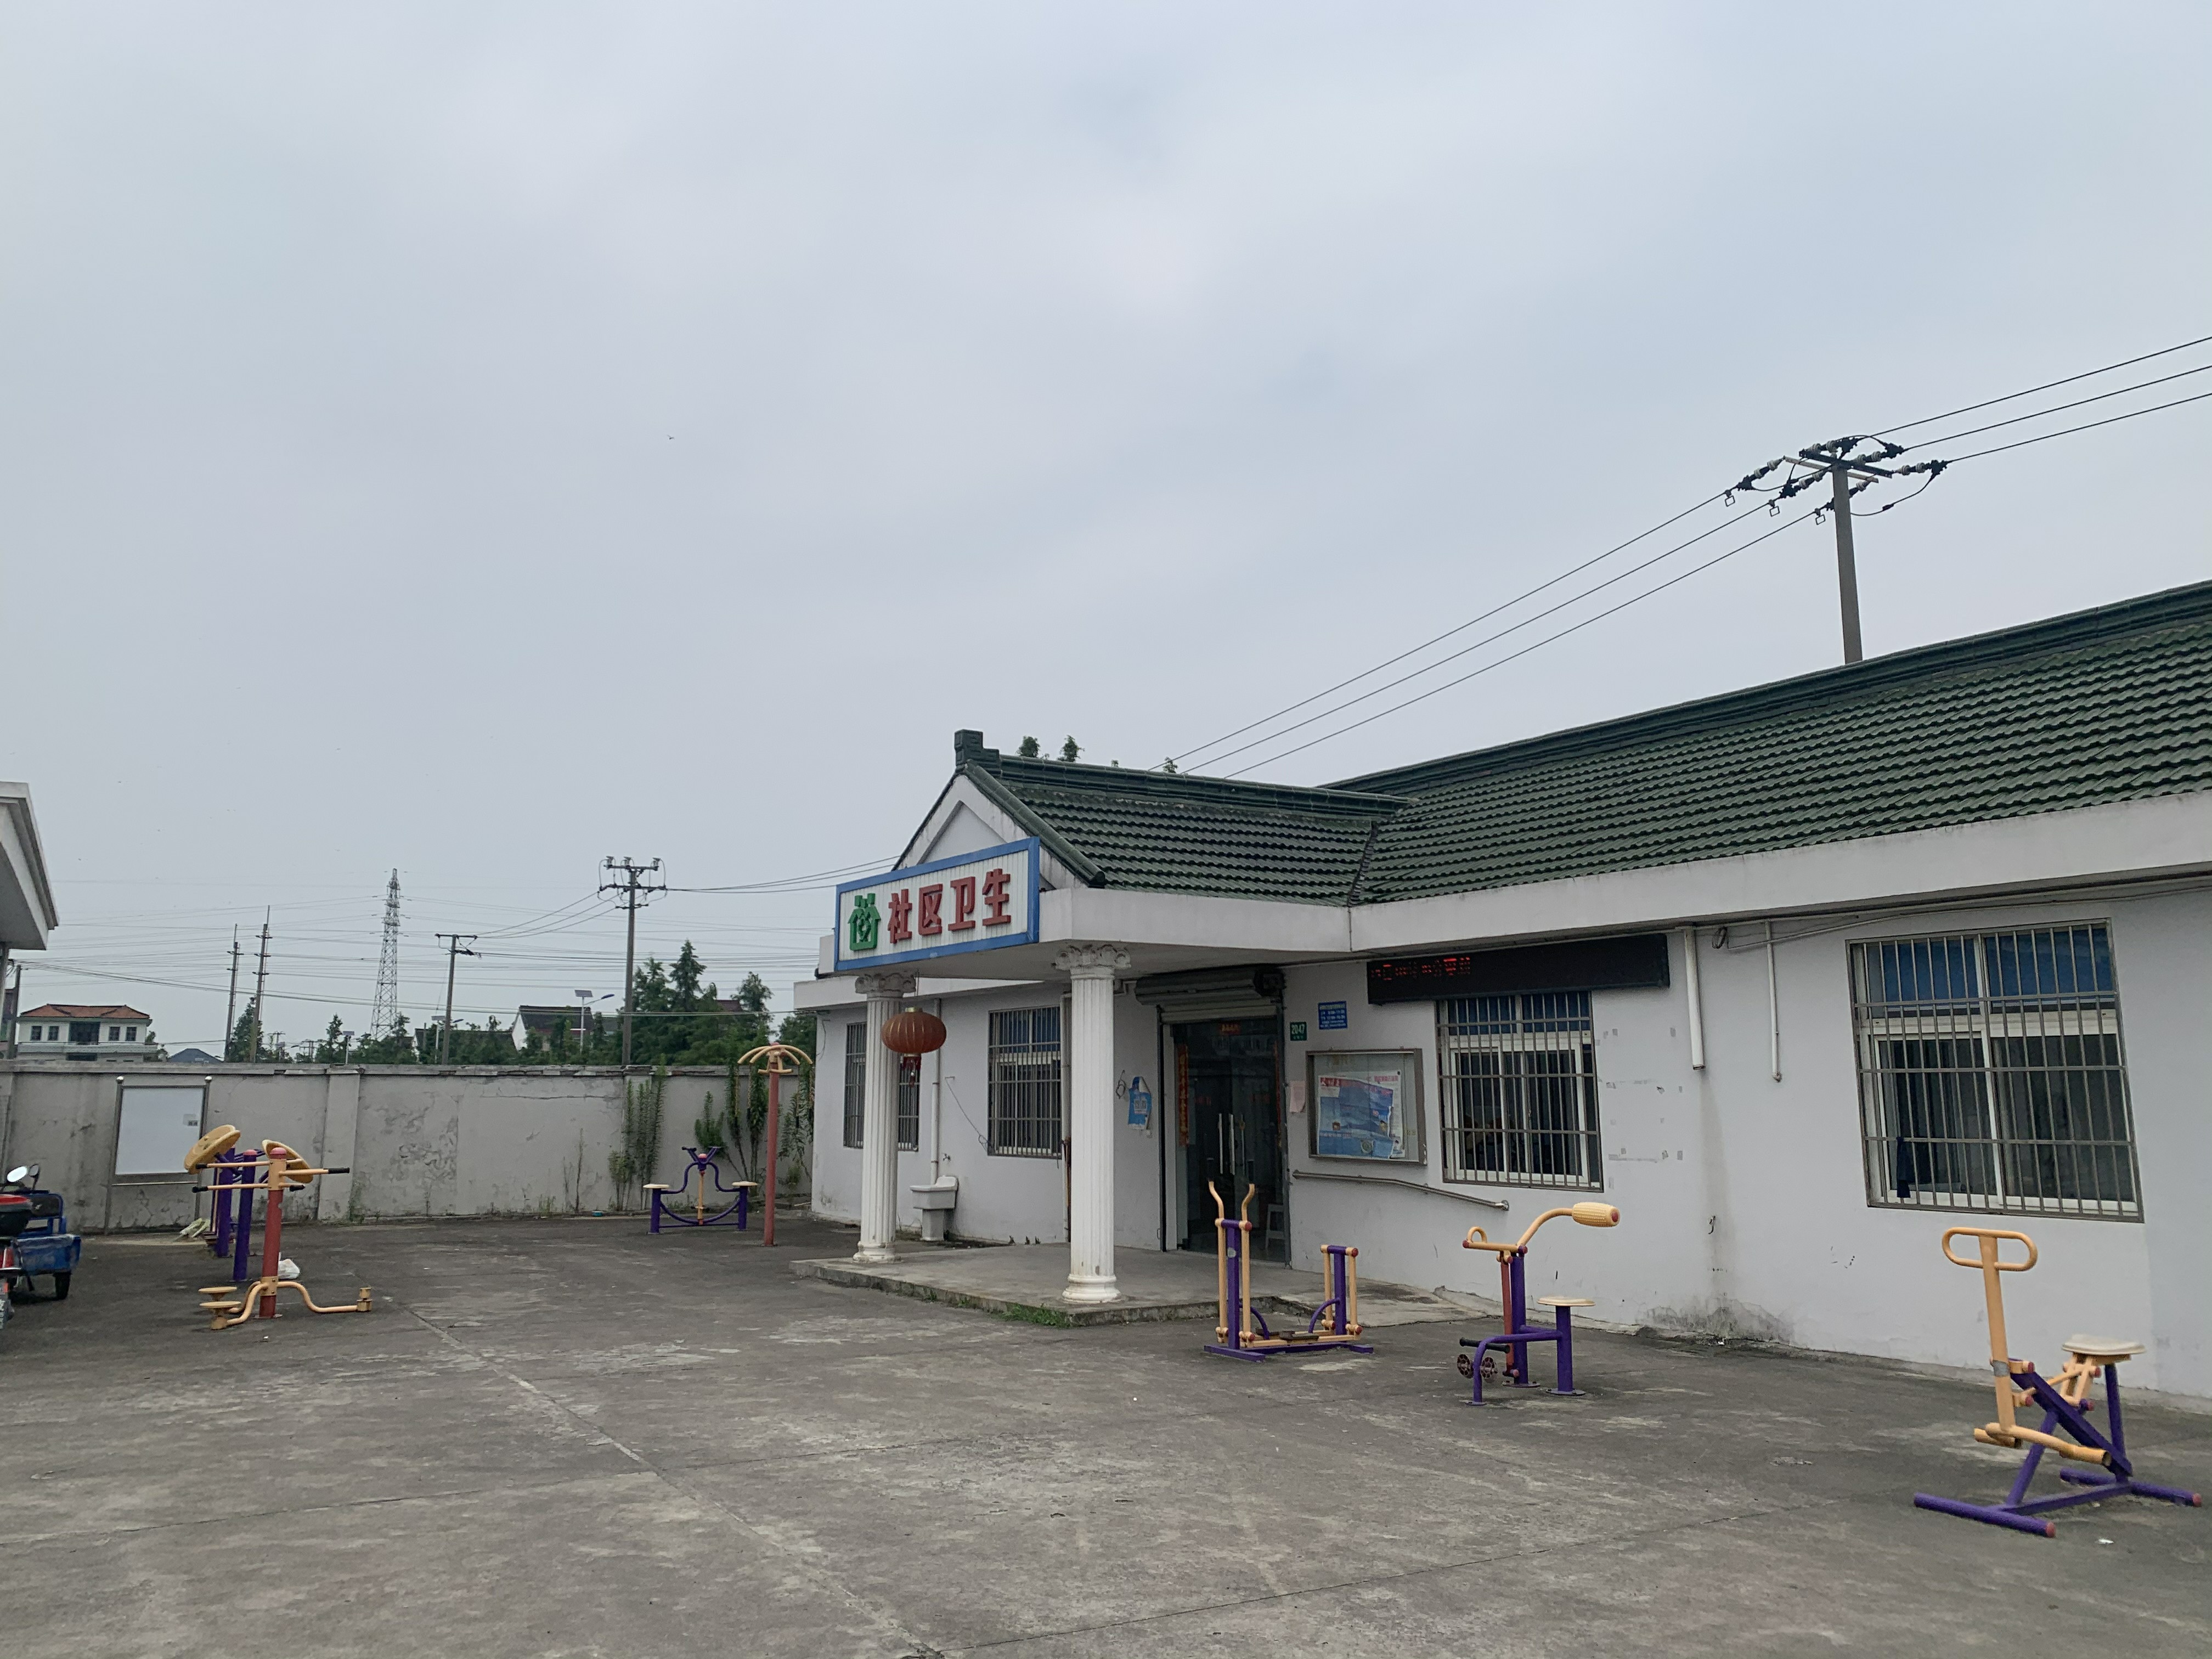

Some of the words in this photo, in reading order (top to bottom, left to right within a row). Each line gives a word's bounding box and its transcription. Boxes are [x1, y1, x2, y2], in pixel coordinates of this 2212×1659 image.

[888, 868, 1011, 944] 社区卫生
[1291, 1024, 1305, 1035] 2047
